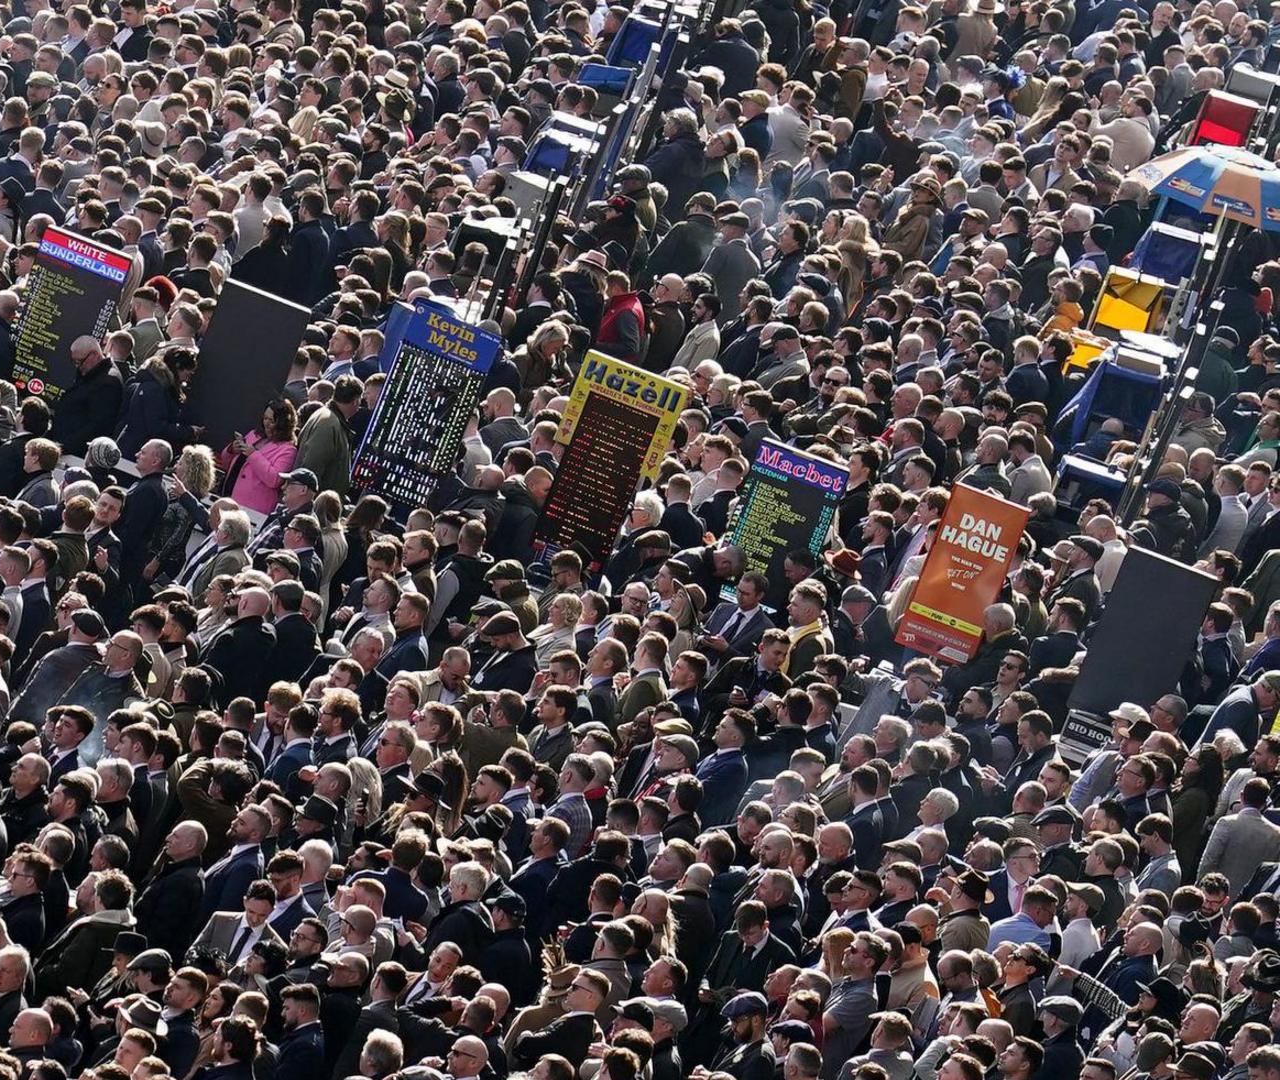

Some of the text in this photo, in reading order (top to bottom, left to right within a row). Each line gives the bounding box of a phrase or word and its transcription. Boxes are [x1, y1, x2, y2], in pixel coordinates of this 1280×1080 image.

[39, 238, 125, 284] SUNDERLAND
[67, 238, 107, 262] WHITE
[427, 313, 475, 341] Kevin
[428, 331, 478, 361] Myles
[585, 360, 680, 411] Hazell
[751, 465, 788, 481] CHELTENHAM
[756, 446, 845, 492] Macbet
[959, 513, 1002, 541] DAN
[940, 525, 1009, 563] HAGUE
[1068, 721, 1088, 735] SID
